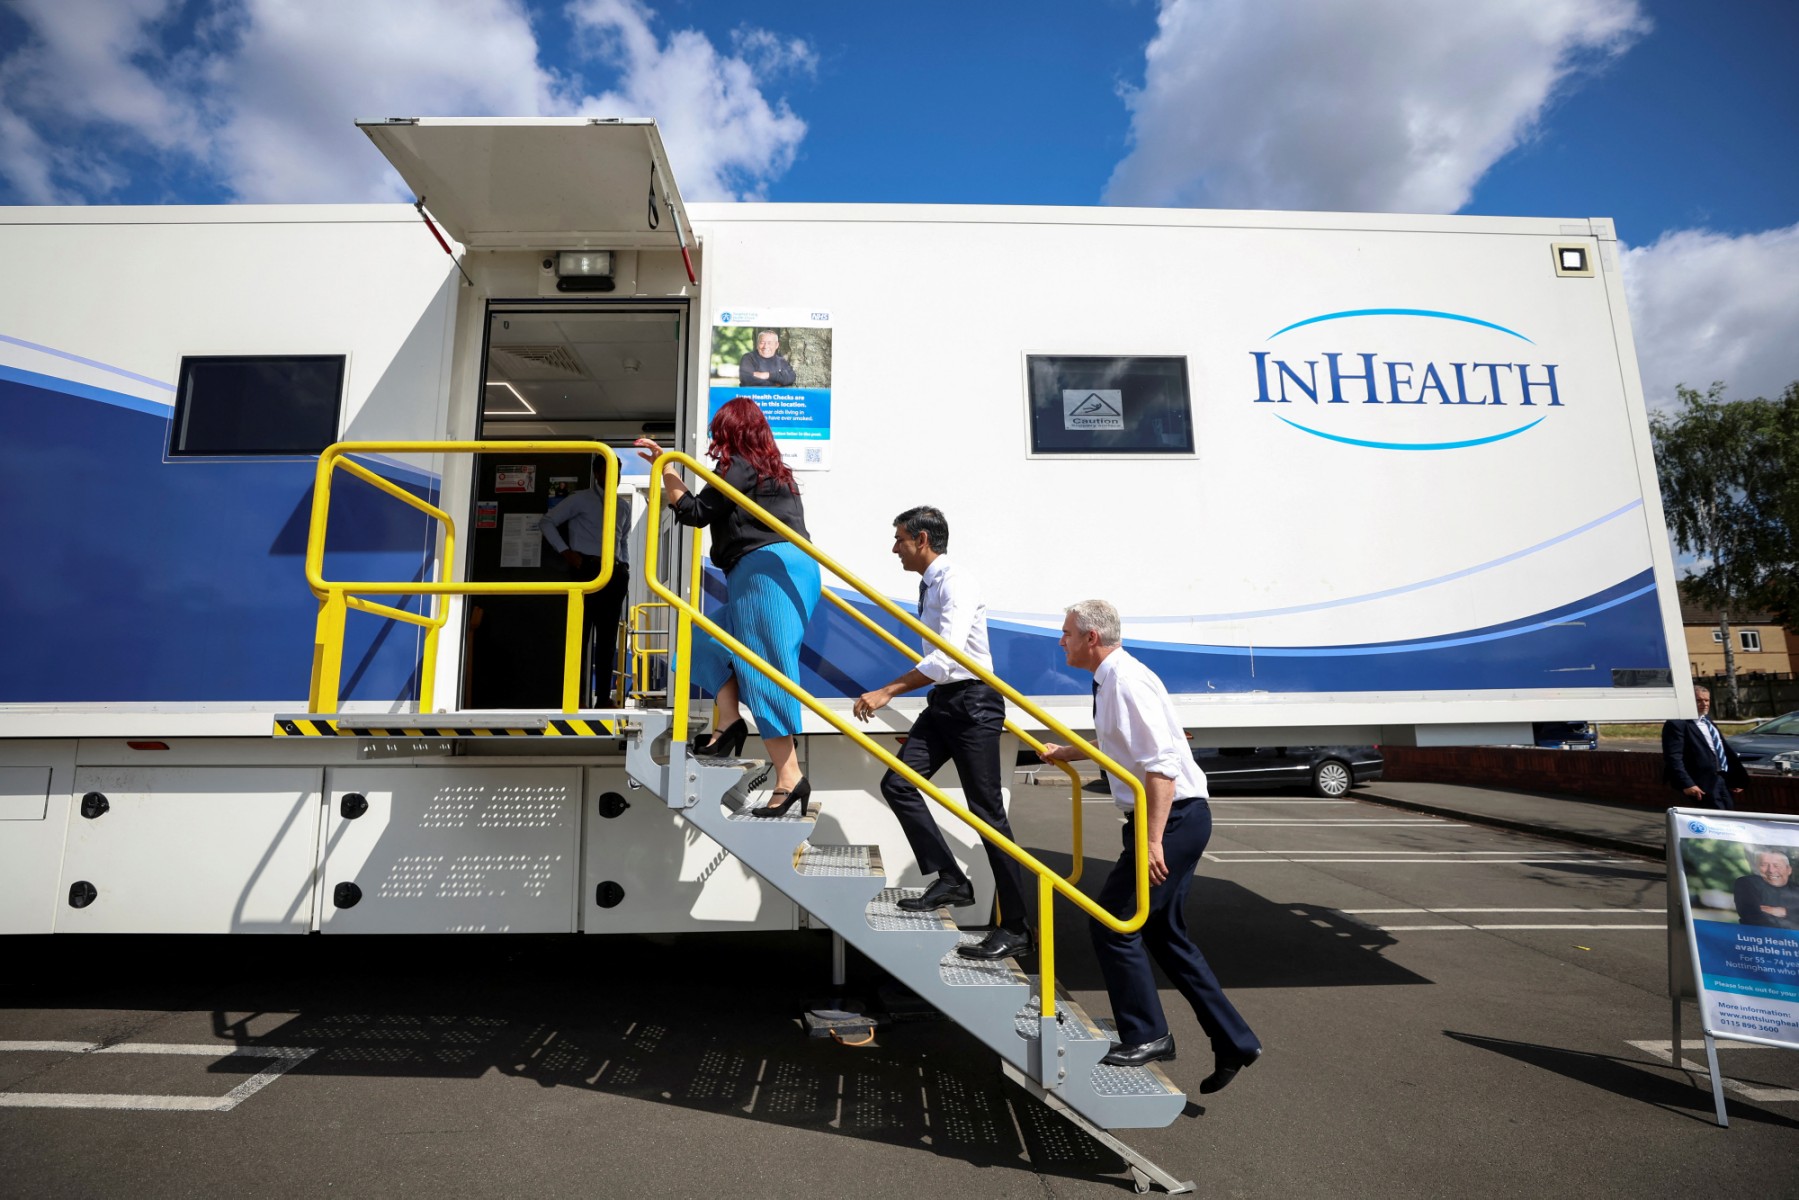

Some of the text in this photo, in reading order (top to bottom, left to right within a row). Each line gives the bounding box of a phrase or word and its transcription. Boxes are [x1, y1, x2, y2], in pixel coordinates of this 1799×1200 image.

[1737, 933, 1799, 948] Lung Health
[1735, 944, 1781, 956] available
[1782, 948, 1792, 957] in
[1740, 954, 1754, 962] For
[1755, 956, 1765, 964] 55
[1773, 958, 1784, 966] 74
[1725, 960, 1797, 976] Nottingham who
[1714, 980, 1737, 989] Please
[1737, 983, 1754, 992] look
[1780, 990, 1797, 998] your
[1718, 1002, 1791, 1019] More information:
[1720, 1018, 1740, 1027] 0115
[1758, 1024, 1779, 1033] 3600
